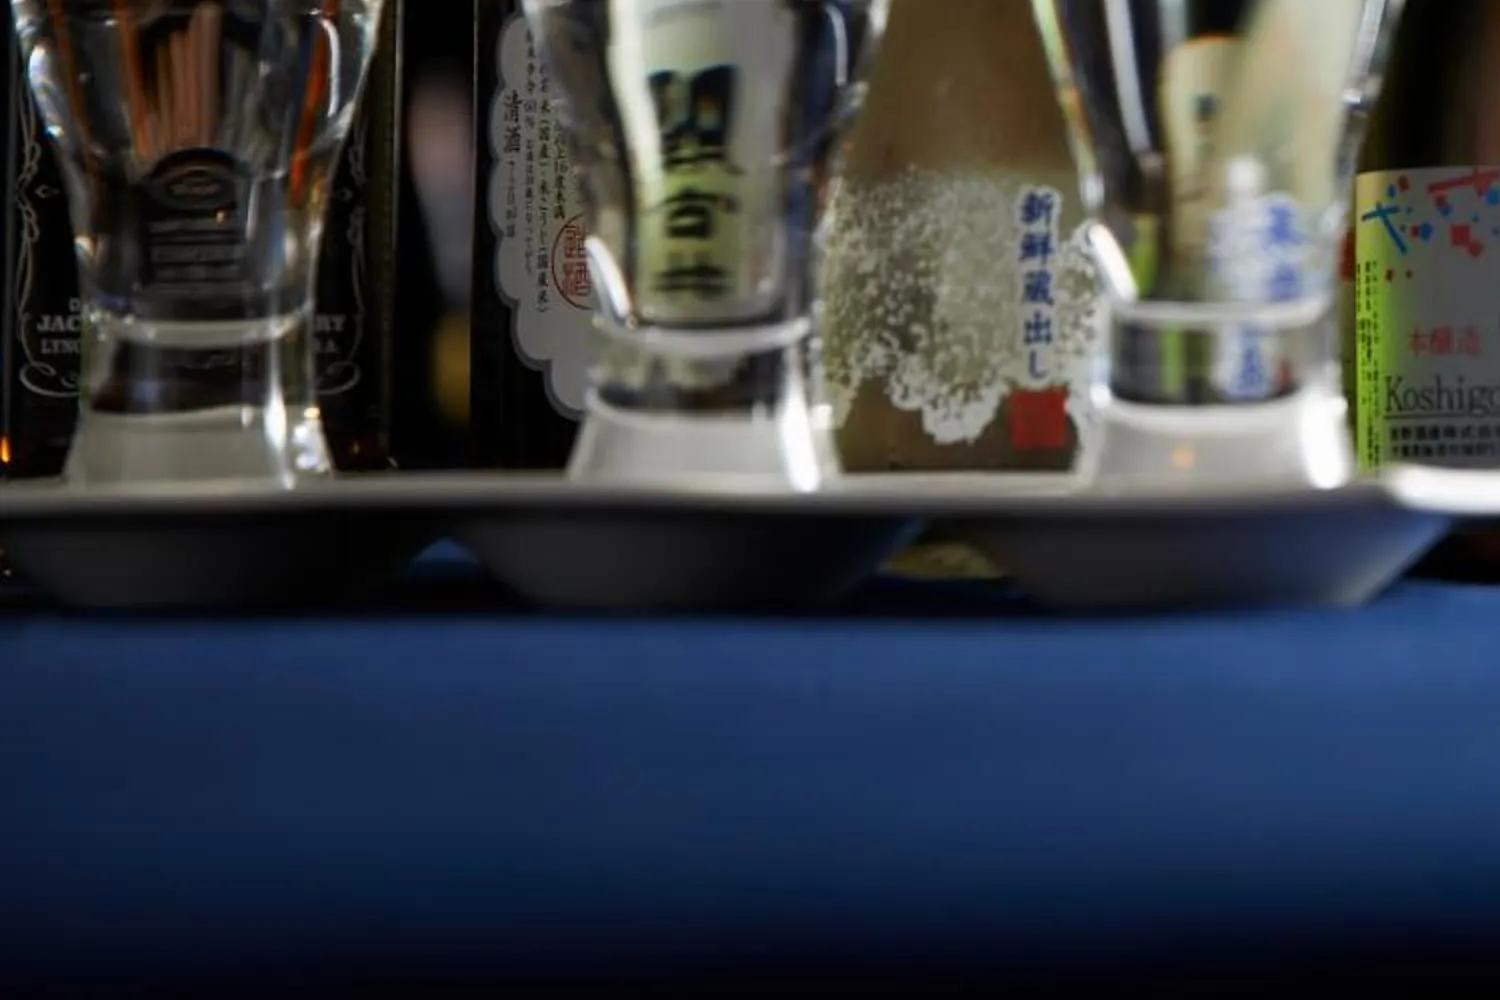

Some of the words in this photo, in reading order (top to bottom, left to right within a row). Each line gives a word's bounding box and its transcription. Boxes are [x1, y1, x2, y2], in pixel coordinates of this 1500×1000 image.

[37, 315, 82, 332] JAC
[1019, 189, 1055, 379] 新鮮蔵出し
